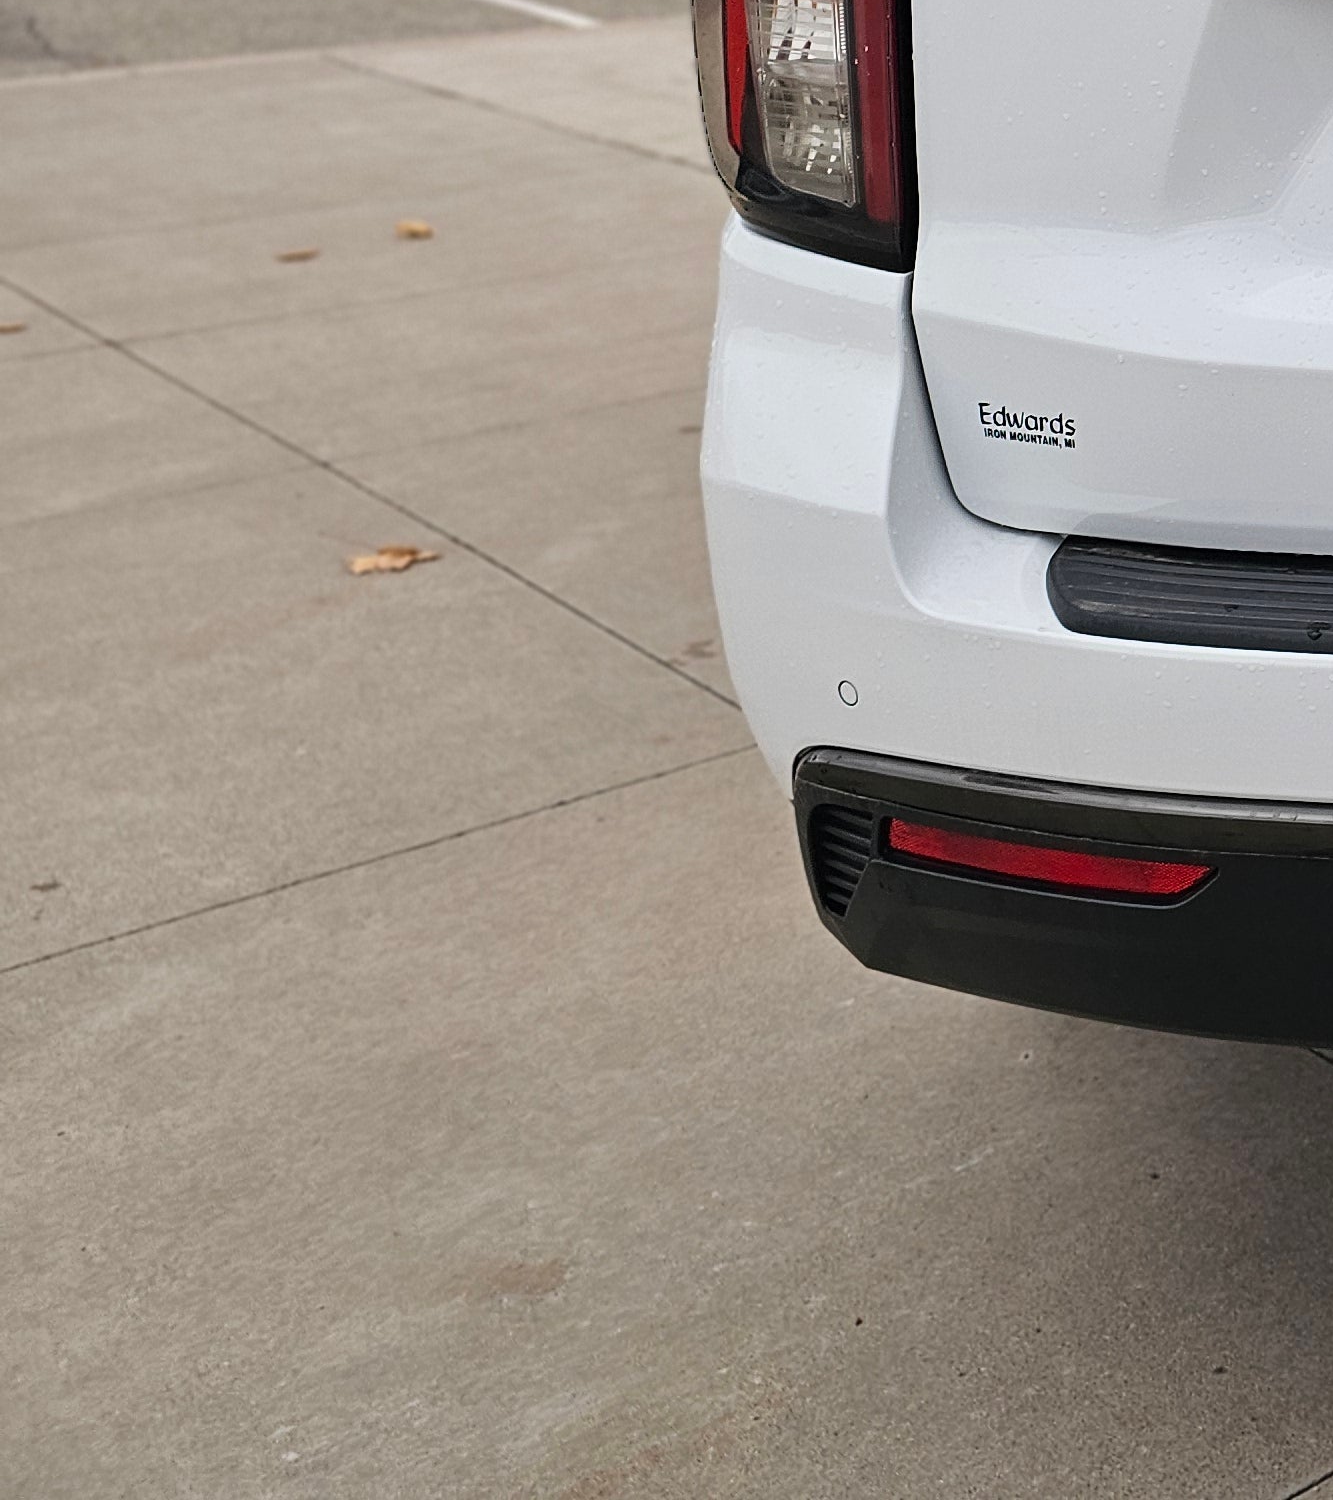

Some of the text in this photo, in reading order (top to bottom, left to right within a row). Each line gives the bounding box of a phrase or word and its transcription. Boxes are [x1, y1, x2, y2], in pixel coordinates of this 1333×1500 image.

[978, 402, 1076, 436] Edwards
[984, 427, 1076, 449] IRON MOUNTAIN, MI
